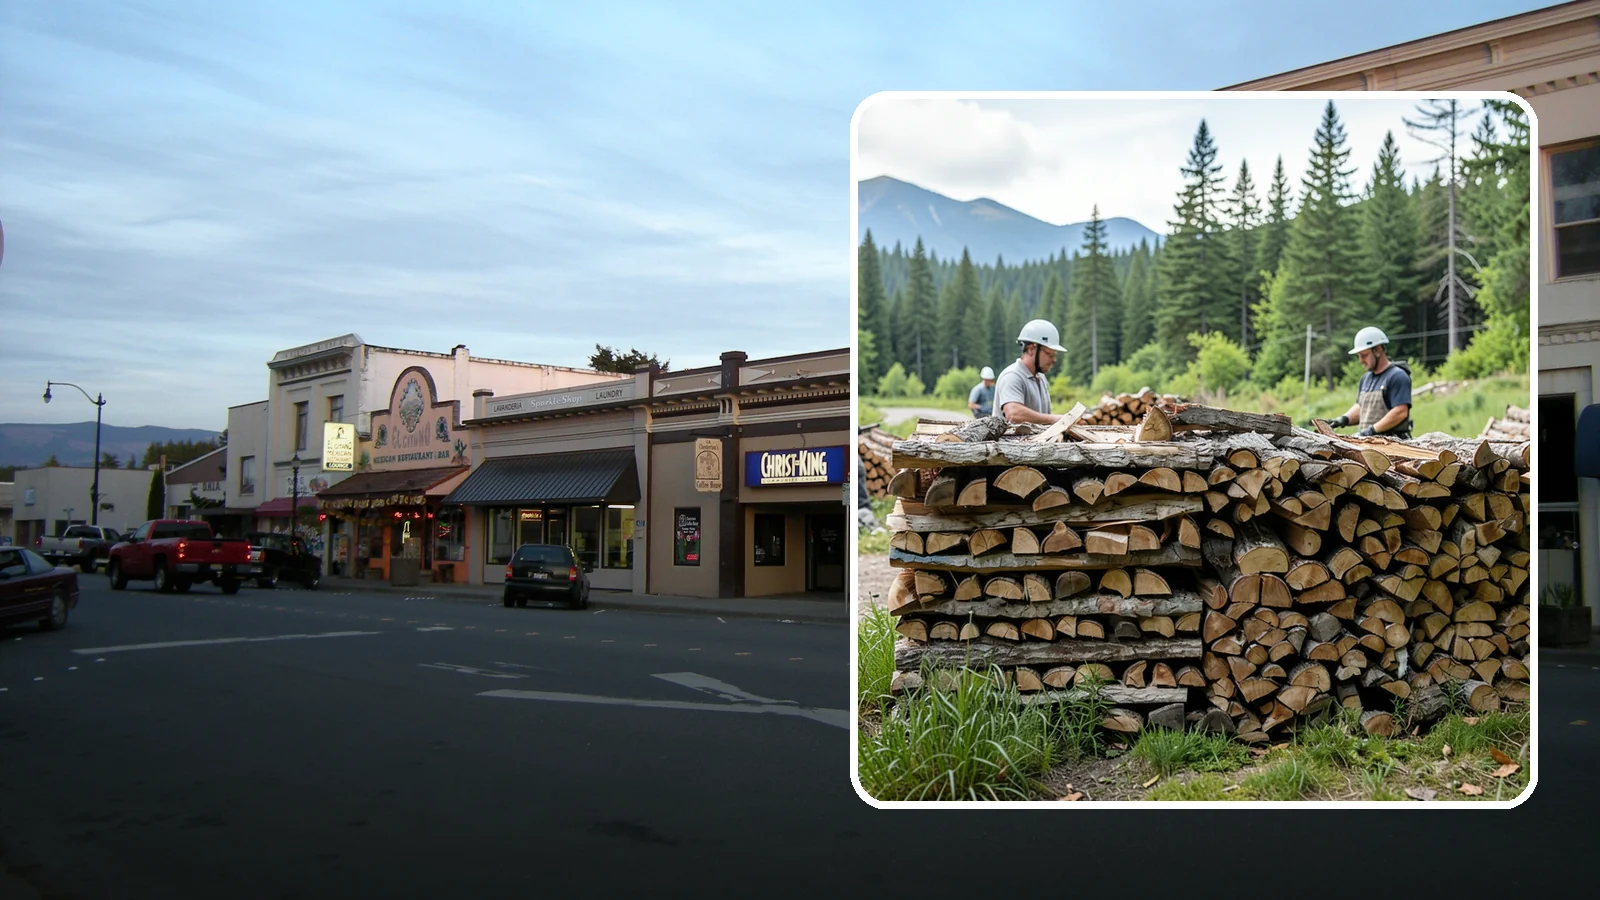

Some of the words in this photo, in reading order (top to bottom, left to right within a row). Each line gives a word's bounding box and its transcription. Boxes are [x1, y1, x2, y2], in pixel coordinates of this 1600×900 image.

[494, 402, 522, 412] LAVANDERIA
[530, 397, 562, 409] Sparkle
[562, 394, 582, 405] Shop
[596, 389, 624, 400] LAUNDRY
[373, 455, 396, 464] MEXICAN
[397, 451, 434, 463] RESTAURANT
[438, 450, 450, 459] BAR
